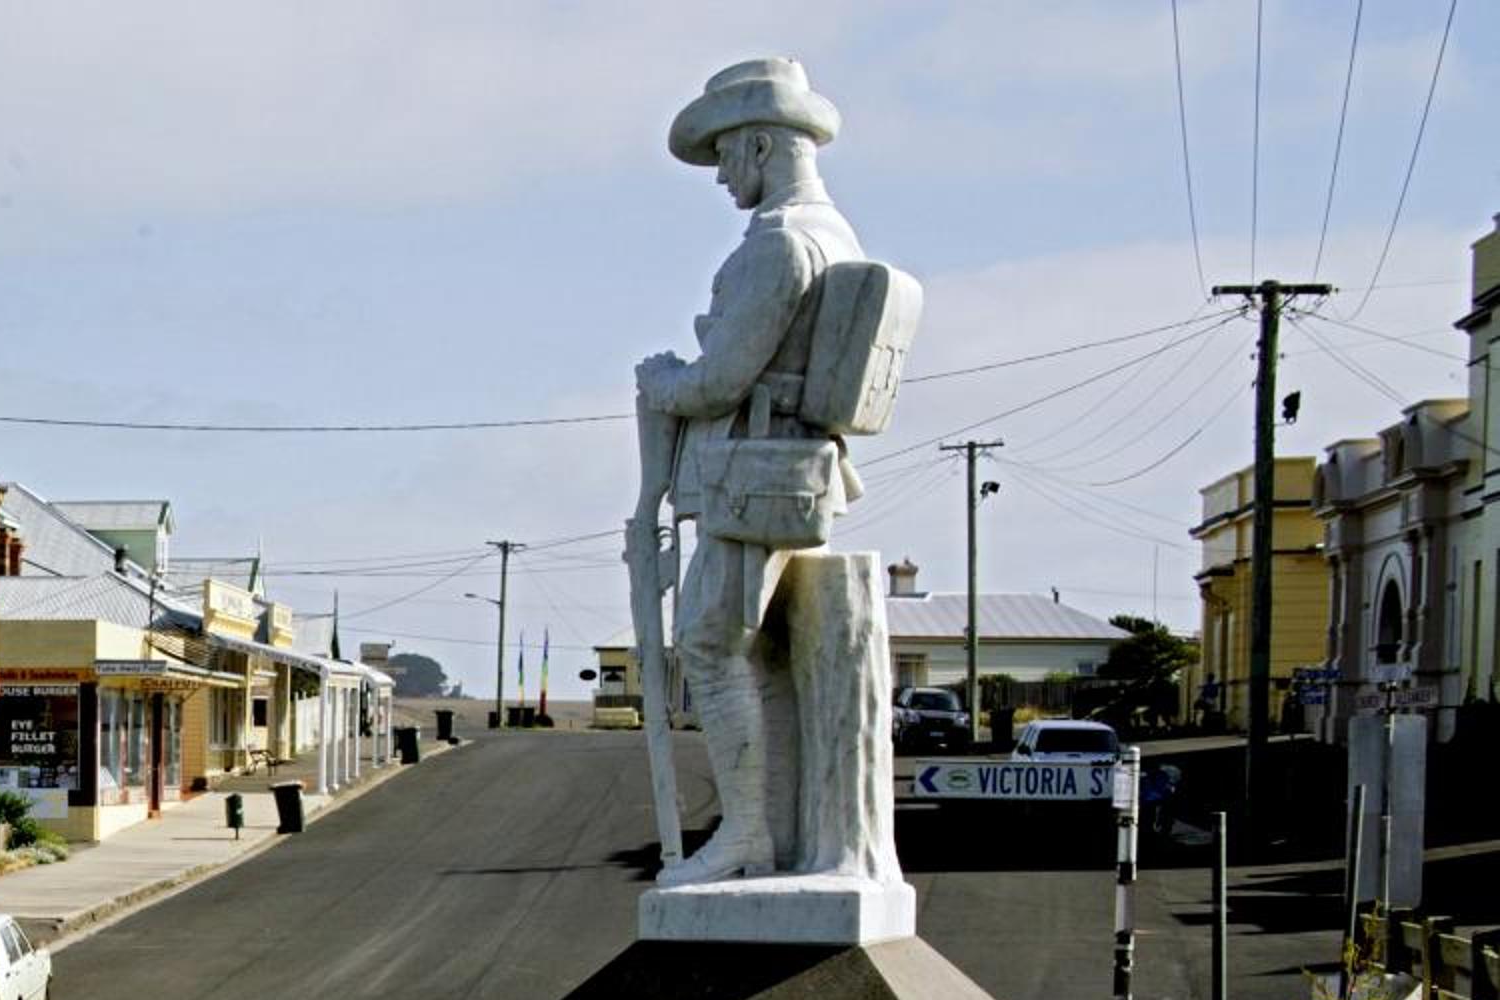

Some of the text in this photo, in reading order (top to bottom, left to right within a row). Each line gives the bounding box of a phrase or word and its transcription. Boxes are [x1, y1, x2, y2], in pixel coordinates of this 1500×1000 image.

[11, 719, 32, 731] EYE
[11, 731, 56, 742] FILLET
[11, 743, 56, 754] BURGER
[978, 766, 1077, 796] VICTORIA
